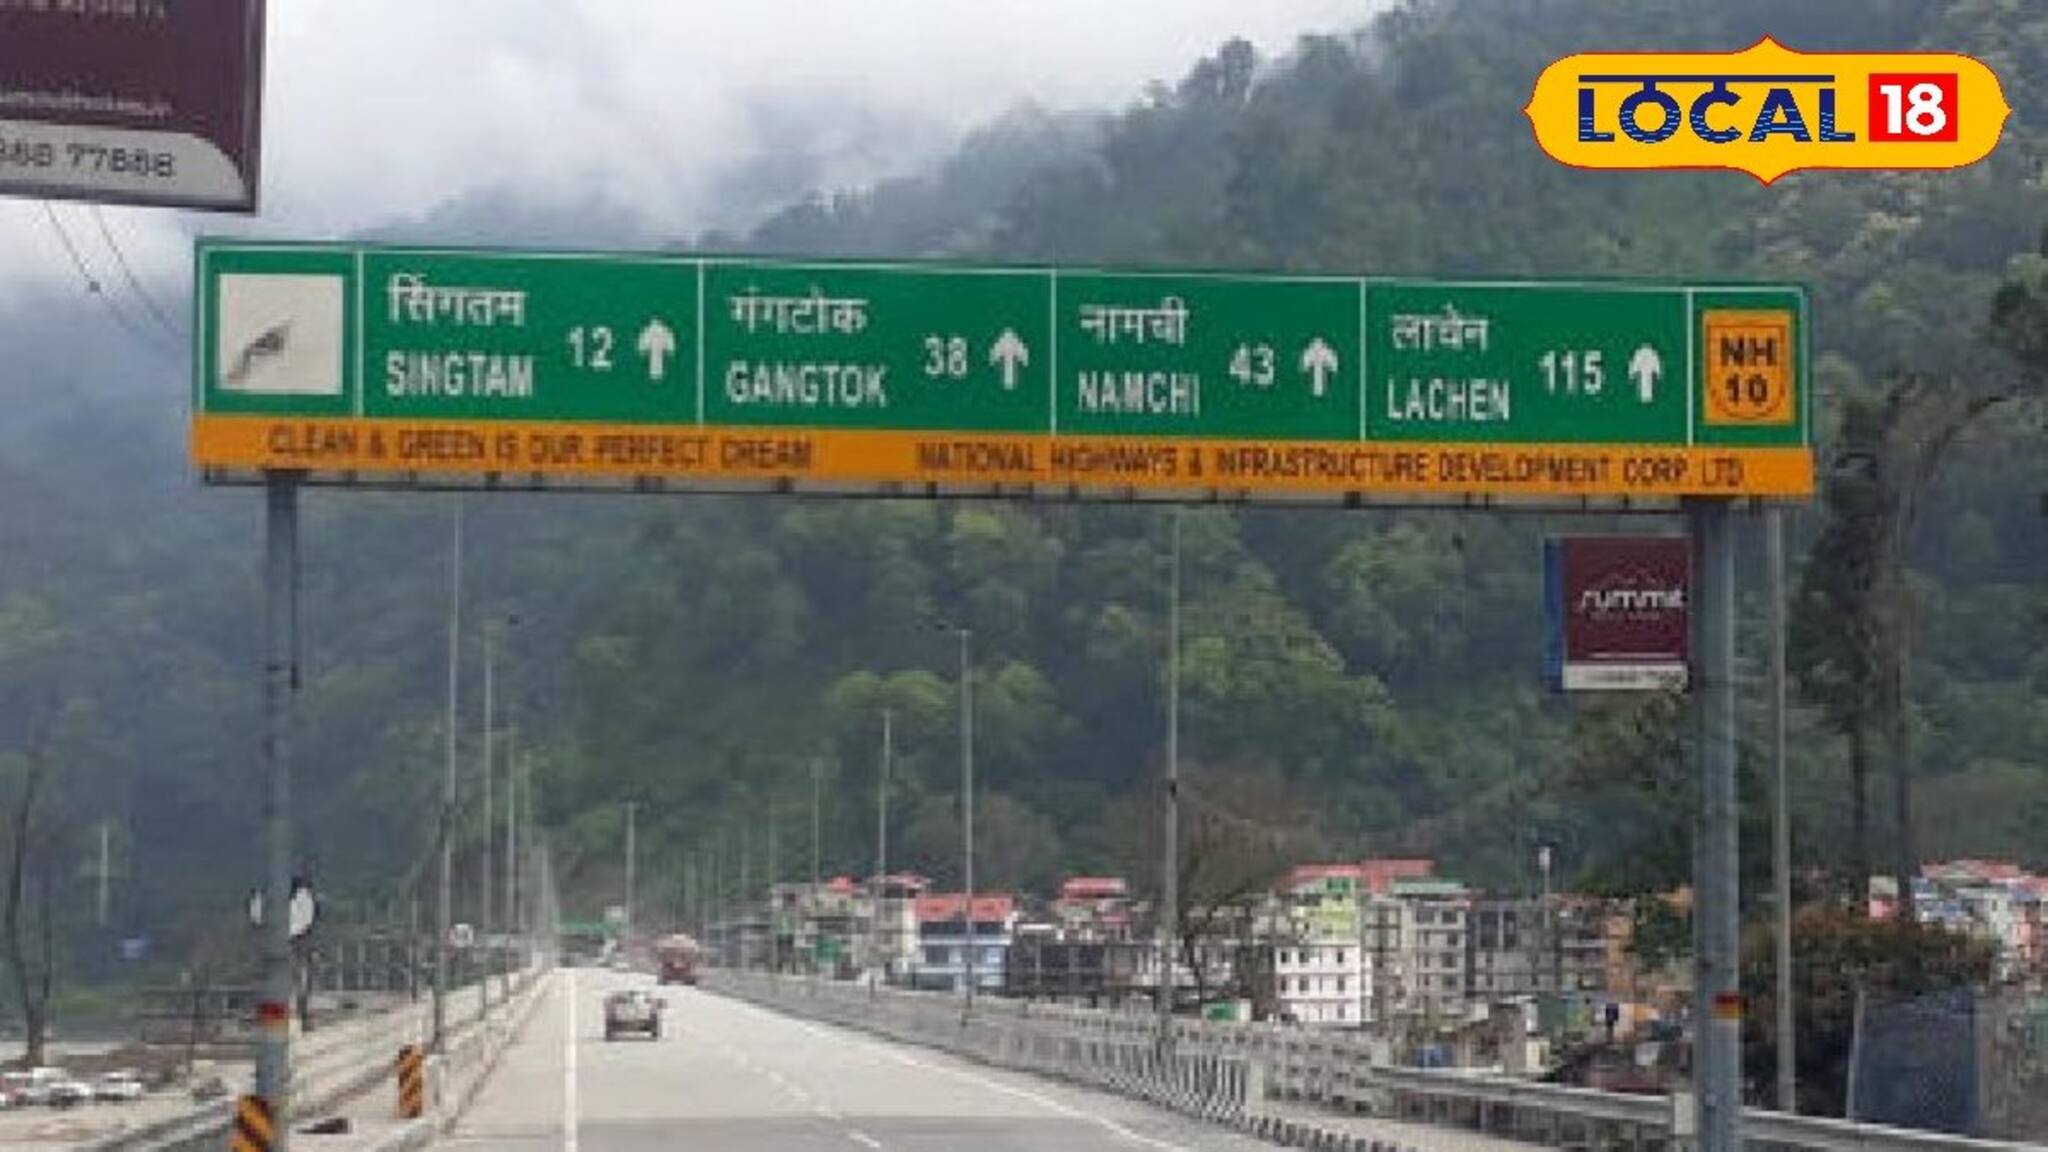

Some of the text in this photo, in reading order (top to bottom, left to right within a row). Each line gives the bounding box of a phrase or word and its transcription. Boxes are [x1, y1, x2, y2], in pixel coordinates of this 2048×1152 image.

[388, 271, 529, 326] सिंगतम
[729, 286, 868, 334] गंगटोक
[1080, 297, 1190, 345] नामची
[568, 326, 613, 370] 12
[925, 335, 968, 378] 38
[1229, 343, 1275, 386] 43
[1720, 336, 1777, 366] NH
[387, 350, 533, 397] SINGTAM
[726, 360, 888, 408] GANGTOK
[1078, 370, 1200, 414] NAMCHI
[1539, 350, 1603, 395] 115
[1727, 377, 1768, 405] 10
[1387, 378, 1510, 422] LACHEN
[268, 427, 812, 470] CLEAN & GREEN IS OUR PERFECT DREAM
[917, 443, 1744, 488] NATIONAL HIGHWAYS & INFRASTRUCTURE DEVELOPMENT CORP LTD
